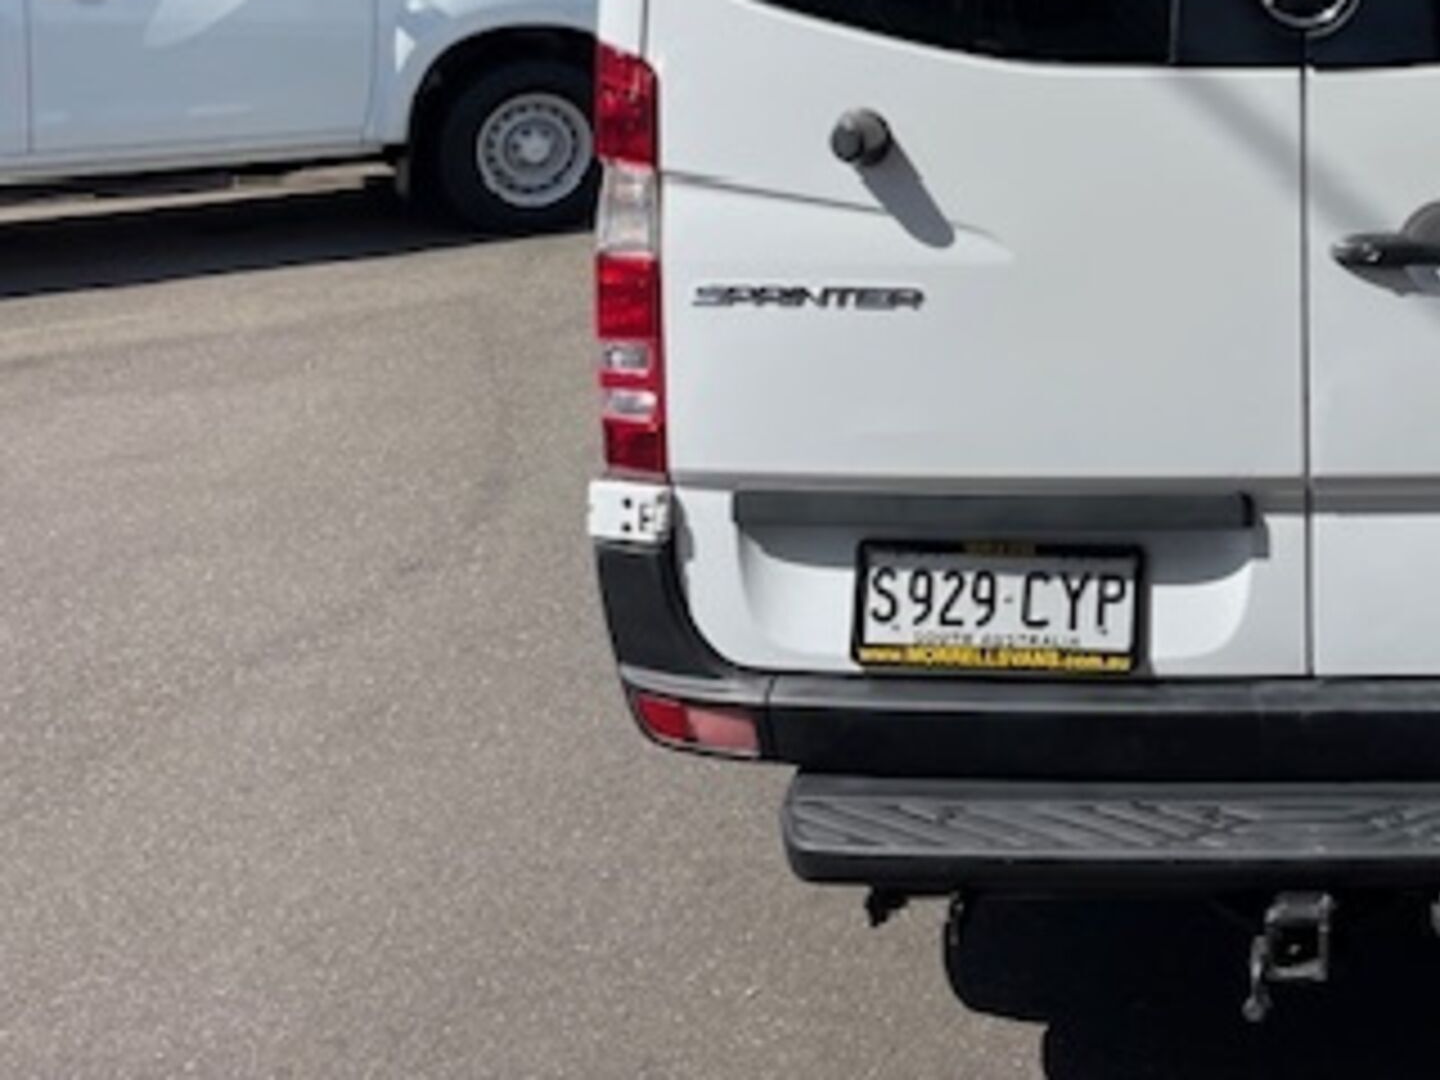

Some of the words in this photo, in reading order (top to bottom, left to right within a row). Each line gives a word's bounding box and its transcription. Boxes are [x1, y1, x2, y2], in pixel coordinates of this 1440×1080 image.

[692, 285, 925, 309] SPRINTER
[871, 566, 996, 627] S929
[1022, 571, 1126, 630] CYP
[981, 632, 1082, 648] AUSTRALIA
